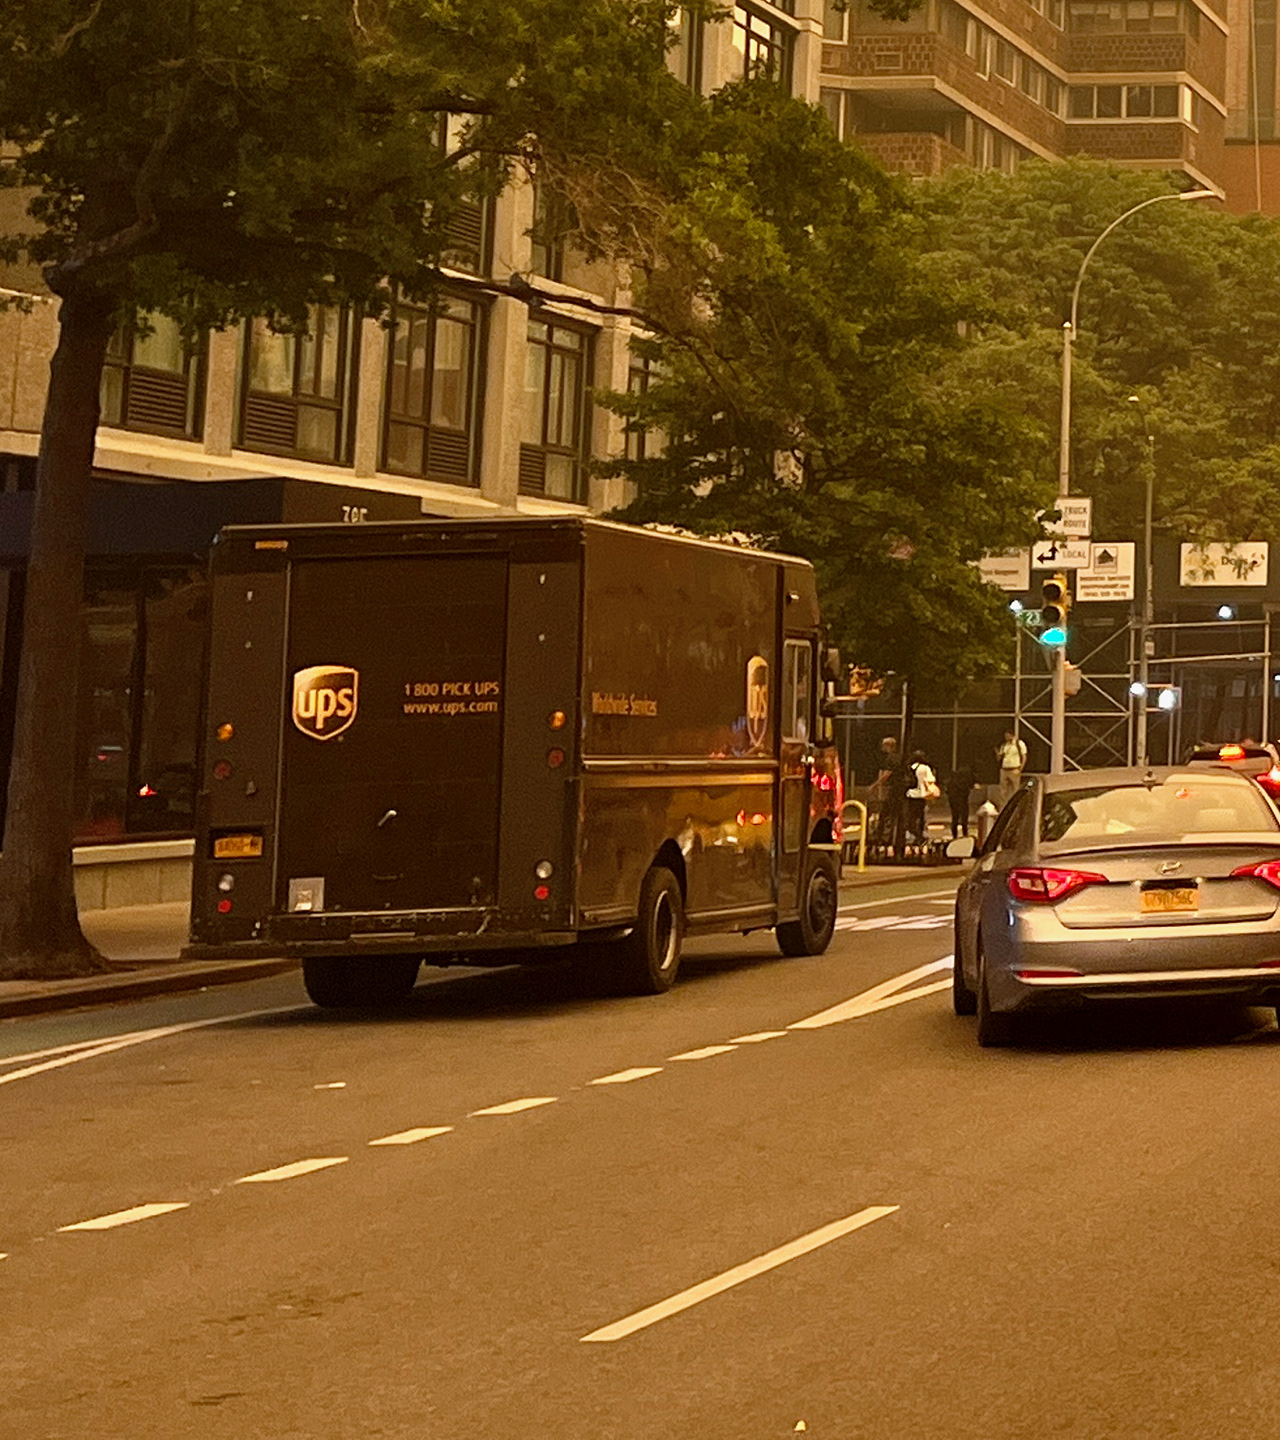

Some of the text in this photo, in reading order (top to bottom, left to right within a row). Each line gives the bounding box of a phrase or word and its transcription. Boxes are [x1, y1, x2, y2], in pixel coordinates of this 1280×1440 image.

[404, 681, 500, 696] 1 800 PICK UPS
[297, 688, 354, 730] ups
[403, 700, 498, 716] www.ups.com
